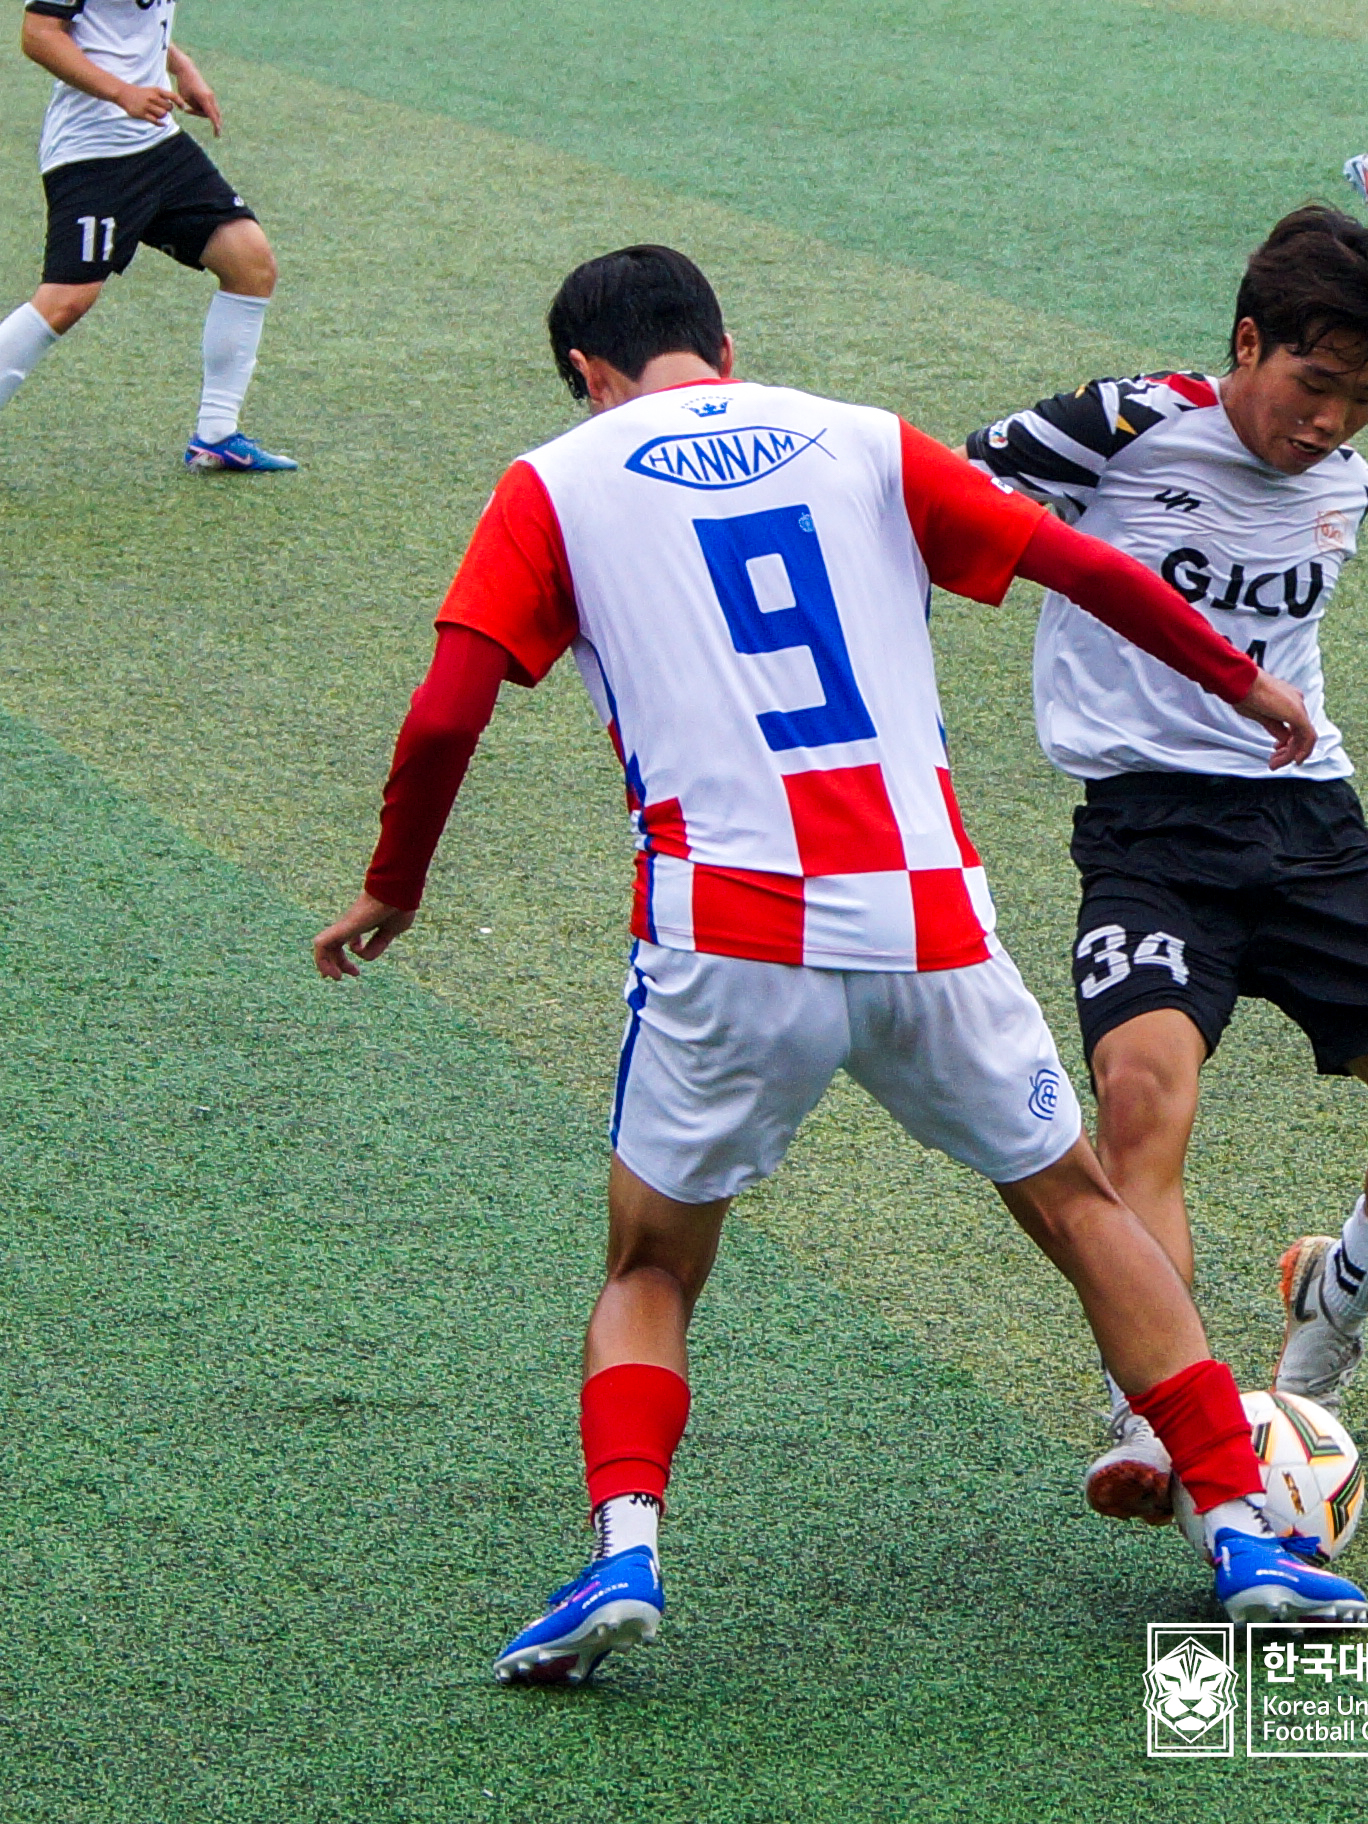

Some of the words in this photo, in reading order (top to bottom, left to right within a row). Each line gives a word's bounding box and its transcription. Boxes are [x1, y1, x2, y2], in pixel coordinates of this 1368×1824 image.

[77, 216, 116, 262] 11
[649, 432, 794, 482] HANNAM
[1160, 547, 1324, 619] GJCU
[692, 503, 878, 752] 9
[1076, 923, 1190, 999] 34
